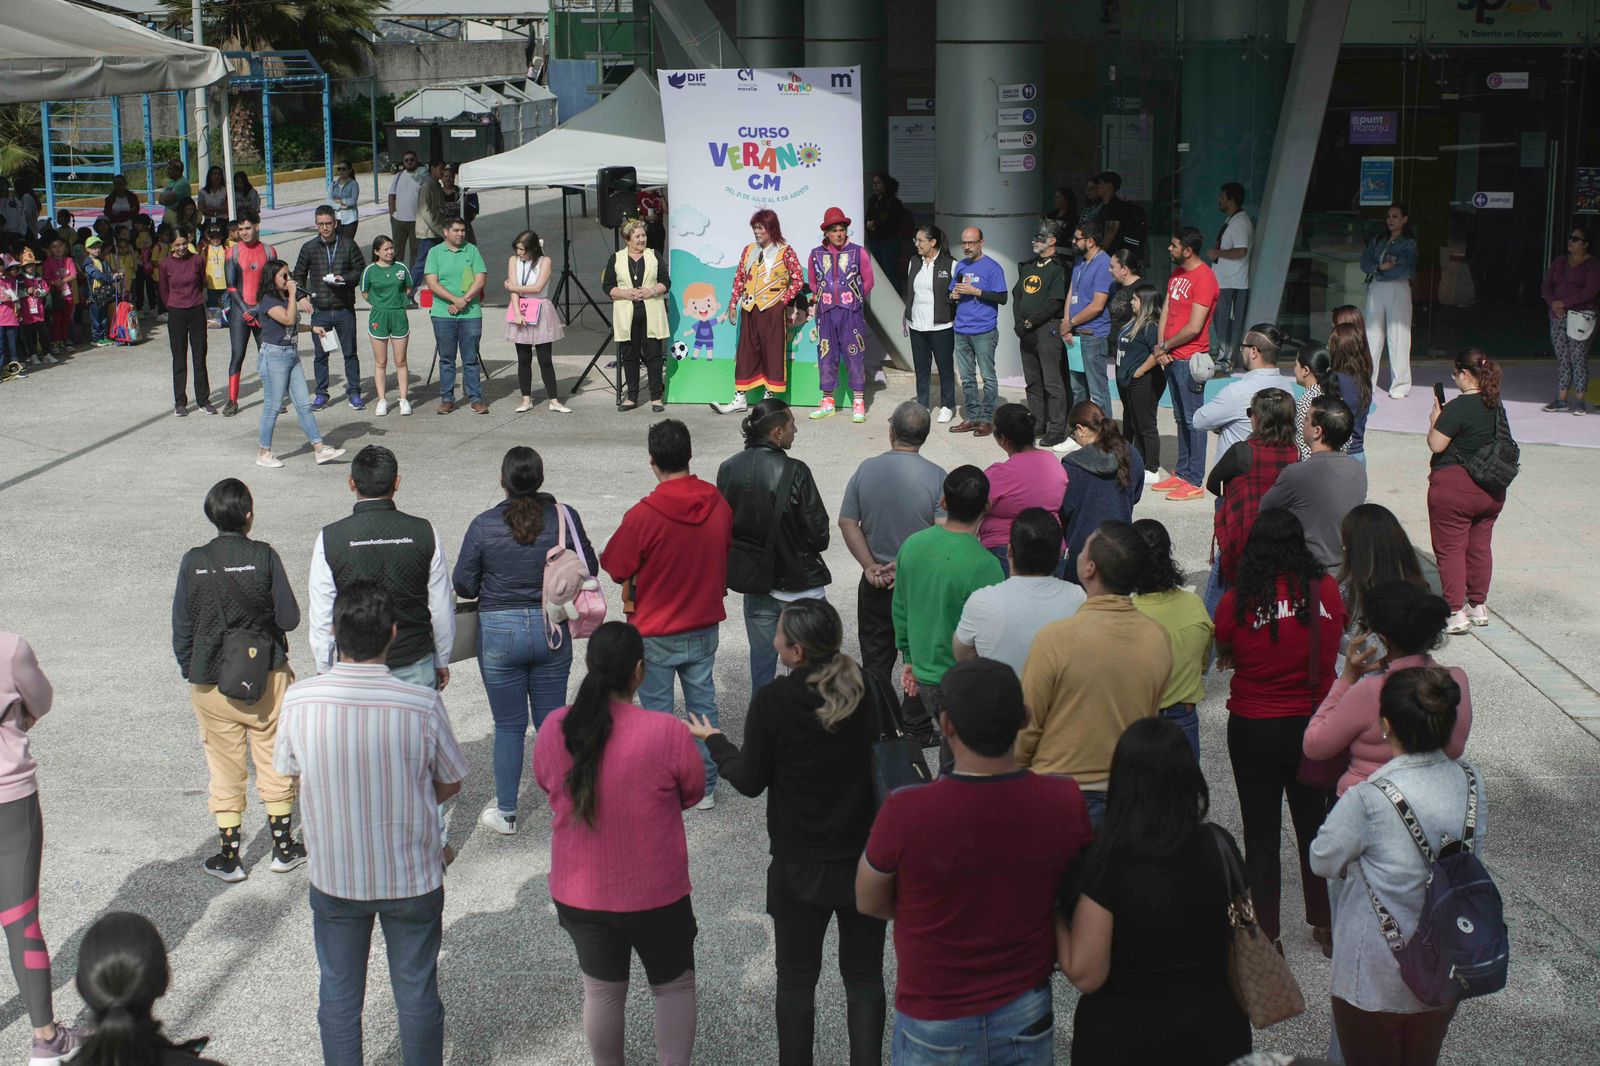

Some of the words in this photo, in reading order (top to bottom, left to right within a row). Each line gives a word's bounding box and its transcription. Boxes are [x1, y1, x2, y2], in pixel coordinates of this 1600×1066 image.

[687, 73, 706, 82] DIF
[777, 83, 812, 92] VERANO
[738, 127, 790, 138] CURSO
[748, 174, 781, 191] CM
[1170, 277, 1192, 299] CHILL
[520, 303, 529, 316] A2
